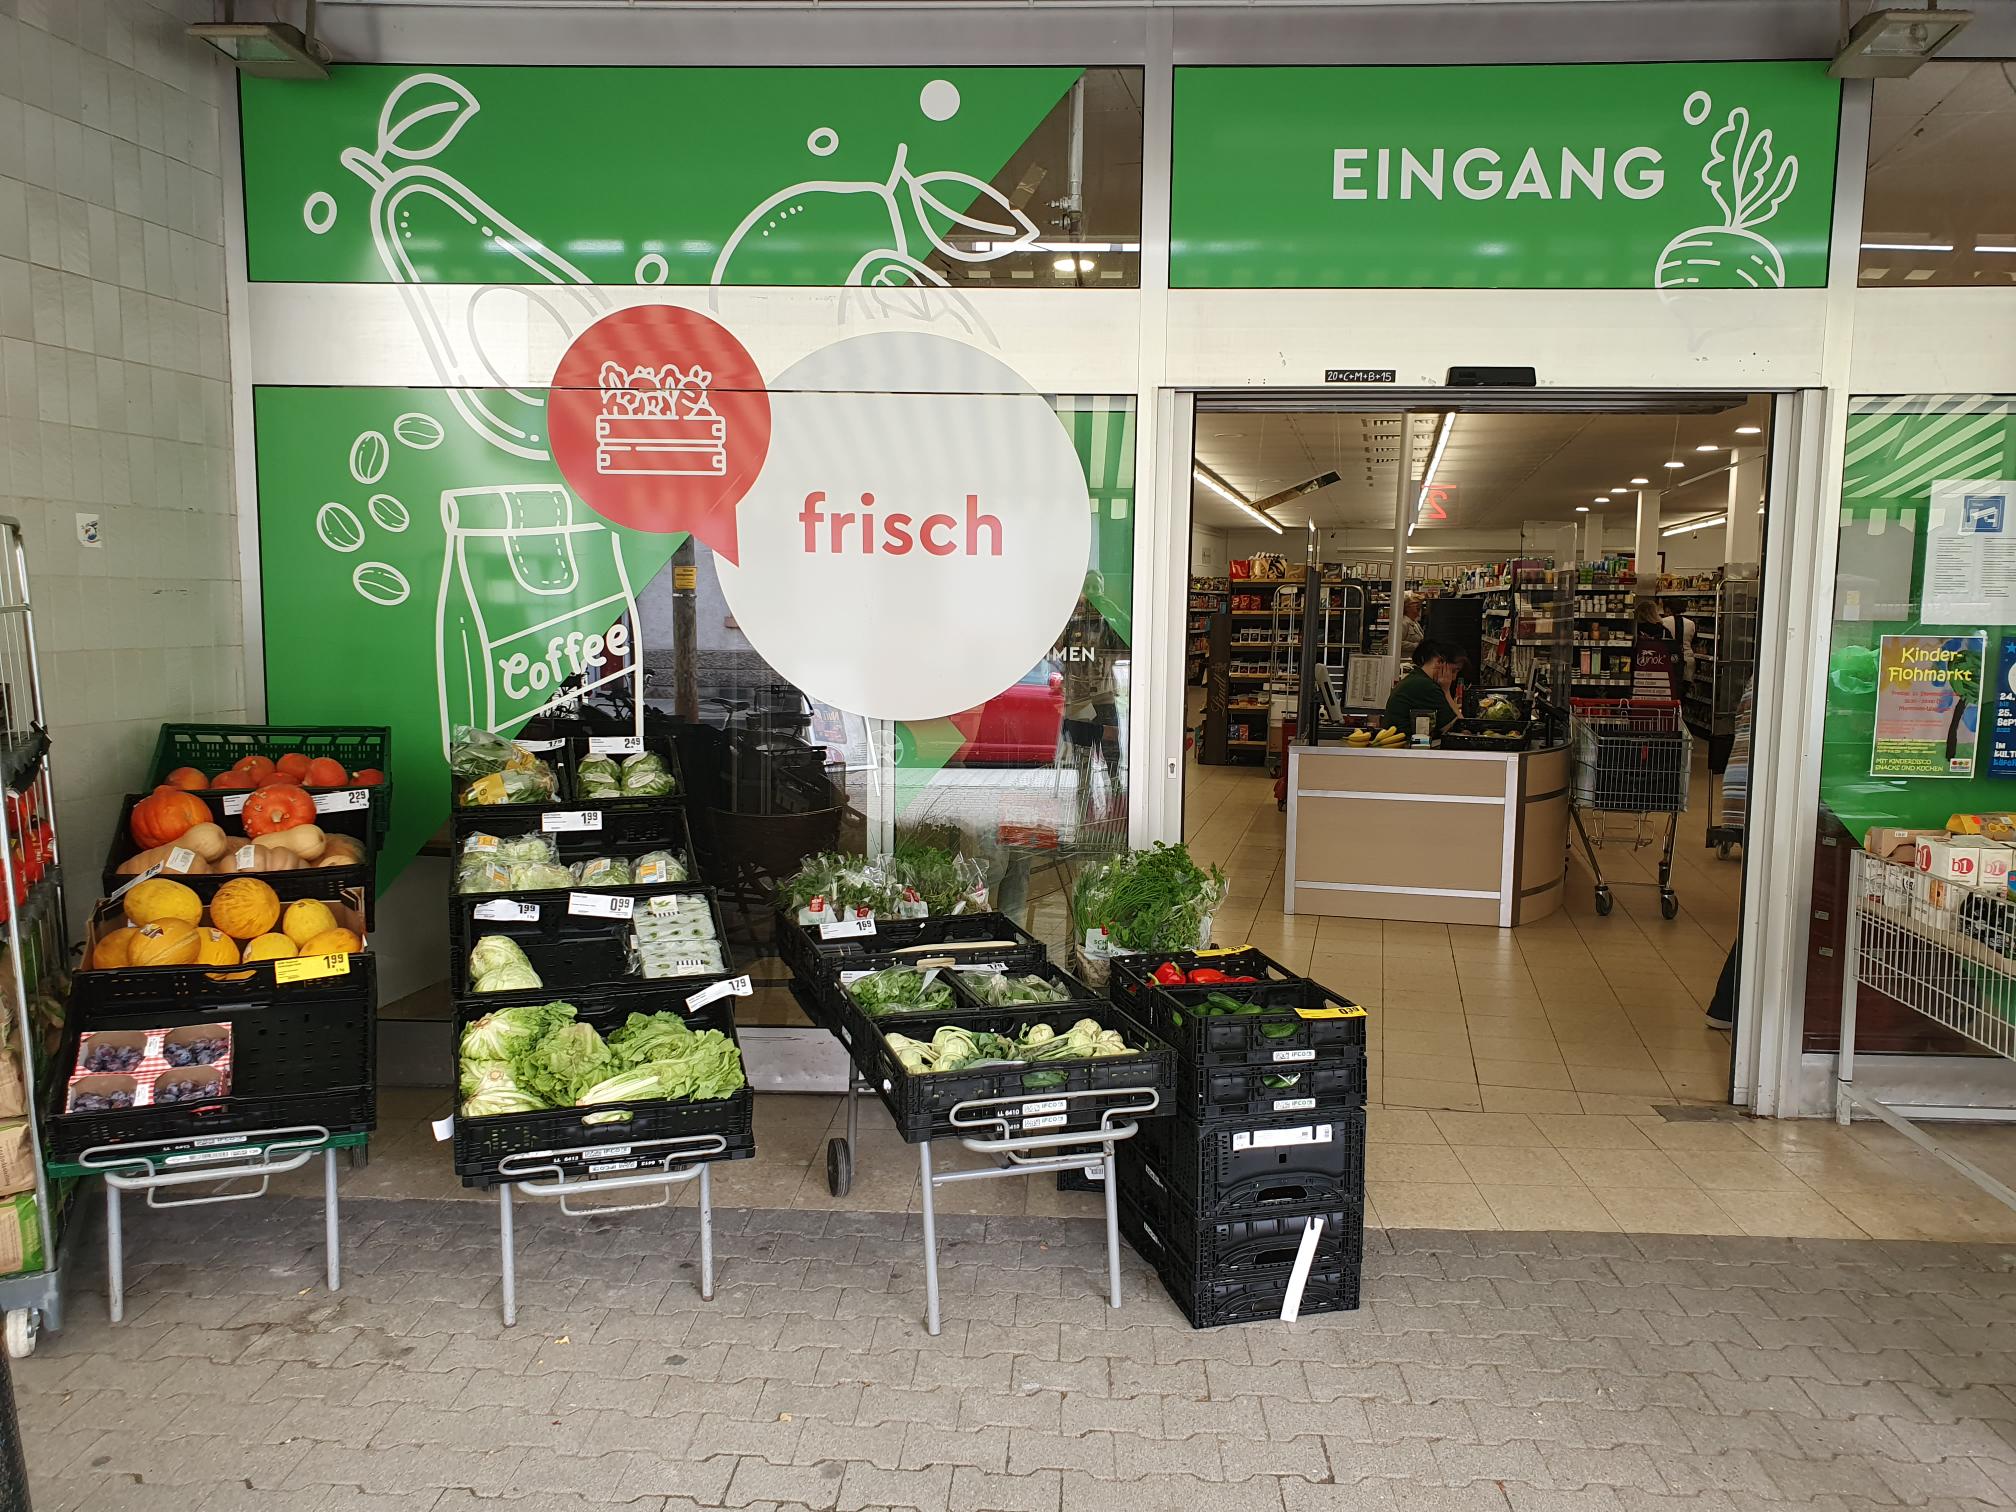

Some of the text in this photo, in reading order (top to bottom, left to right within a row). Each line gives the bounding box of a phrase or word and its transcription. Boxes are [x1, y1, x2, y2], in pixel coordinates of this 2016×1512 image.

[1332, 147, 1665, 200] EINGANG
[799, 491, 1003, 556] frisch
[498, 623, 630, 700] Coffee
[1901, 647, 1963, 663] Kinder-
[1888, 666, 1972, 682] Flohmarkt
[624, 737, 640, 749] 2.49
[348, 791, 366, 804] 2.29
[580, 812, 598, 824] 1.99
[517, 904, 536, 914] 1.99
[610, 898, 630, 911] 0.99
[856, 920, 872, 931] 1.69
[323, 953, 344, 969] 1.99
[728, 978, 747, 991] 1.79
